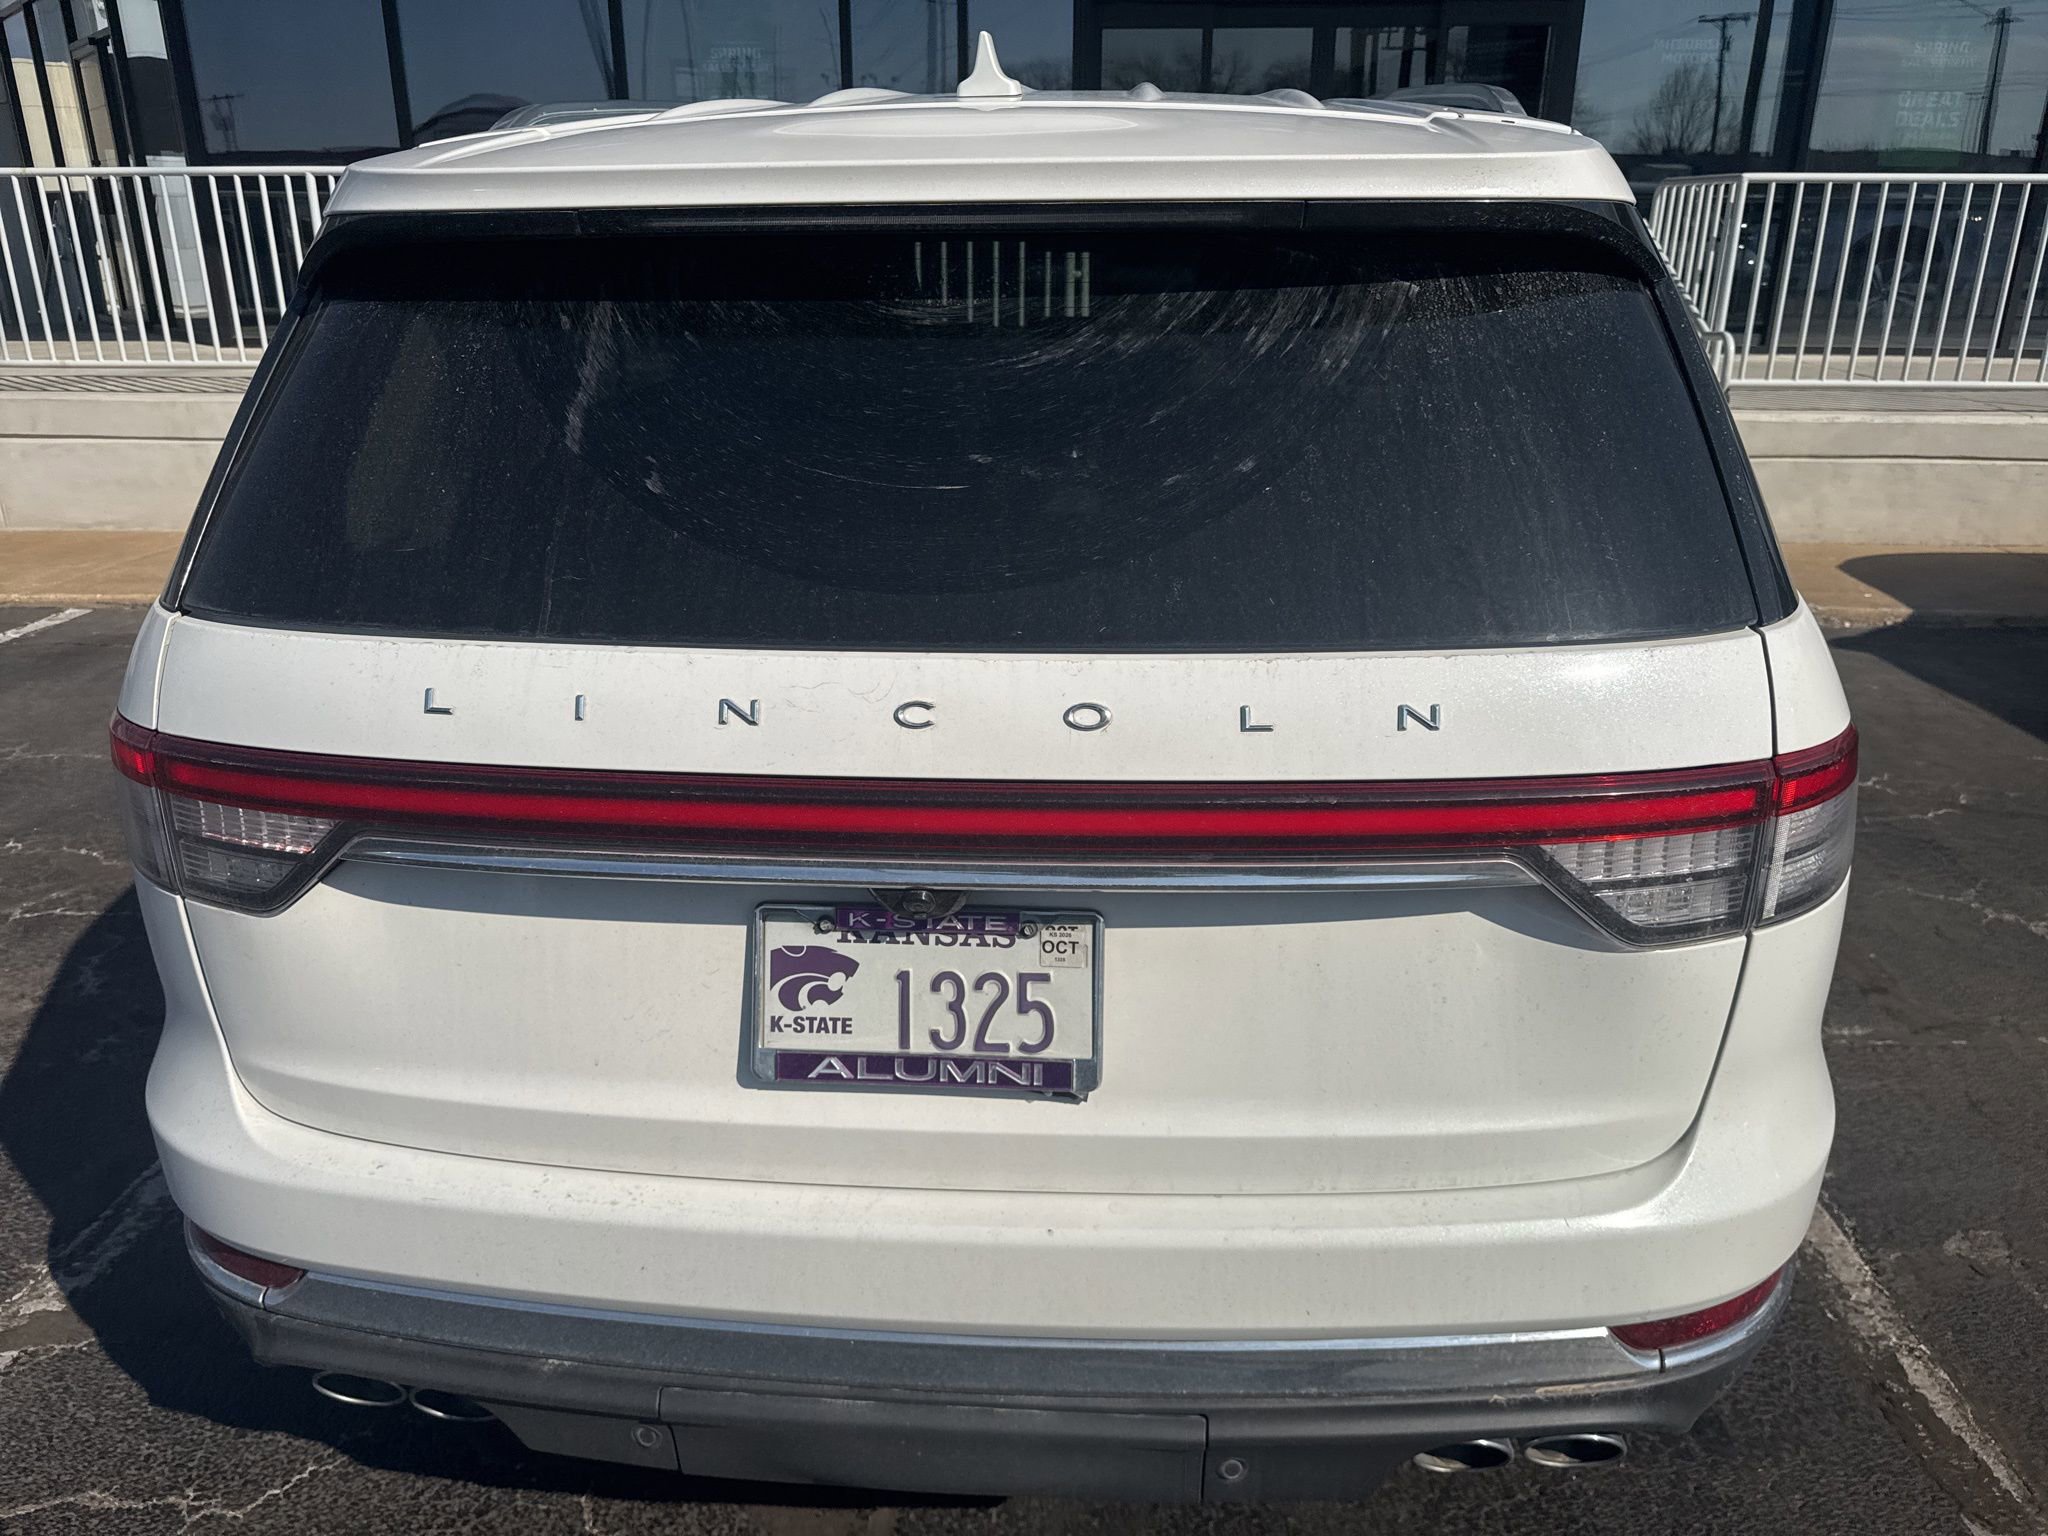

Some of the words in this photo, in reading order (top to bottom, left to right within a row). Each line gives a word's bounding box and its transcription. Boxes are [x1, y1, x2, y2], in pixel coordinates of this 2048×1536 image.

[423, 687, 1441, 732] LINCOLN
[1042, 940, 1080, 954] OCT
[770, 1015, 853, 1034] K-STATE
[895, 969, 1056, 1054] 1325
[807, 1056, 1044, 1086] ALUMNI
